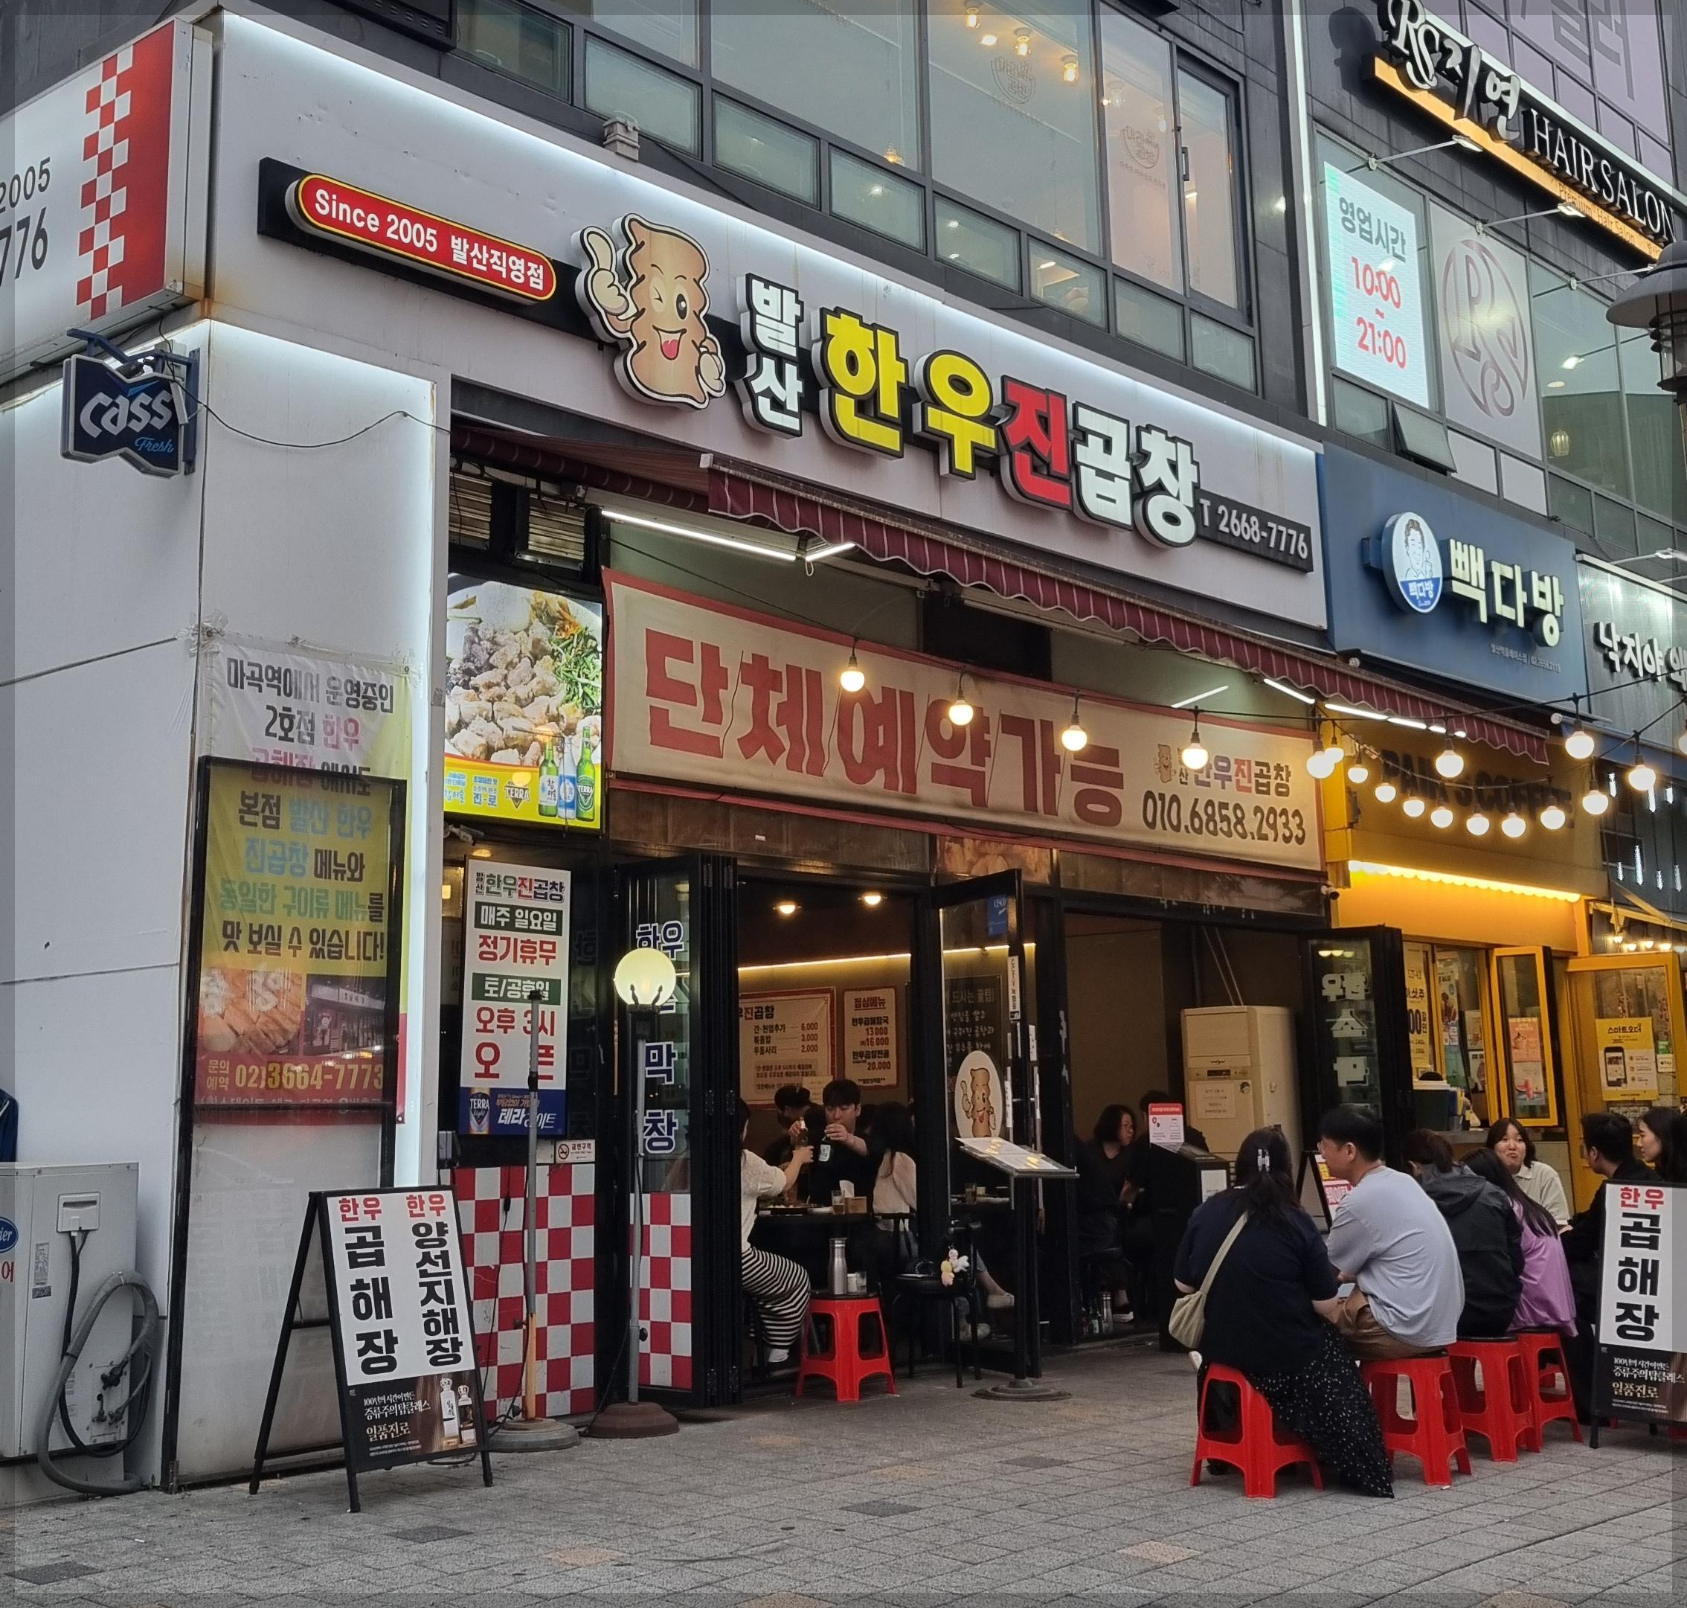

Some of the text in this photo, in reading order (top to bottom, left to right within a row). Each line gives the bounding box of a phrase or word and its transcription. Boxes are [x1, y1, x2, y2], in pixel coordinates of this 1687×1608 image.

[0, 157, 50, 213] 2005
[1530, 108, 1677, 243] HAIR SALON
[314, 189, 438, 254] Since 2005
[1339, 196, 1407, 263] 영업시간
[450, 236, 545, 291] 발산직영점
[1351, 256, 1402, 309] 10:00
[750, 278, 803, 431] 발산
[1356, 316, 1407, 370] 21:00
[134, 436, 175, 454] Fresh
[824, 311, 1200, 546] 한우진곱창
[1201, 501, 1310, 560] T 2668-7776
[1449, 538, 1565, 648] 빽다방
[1599, 621, 1665, 682] 낙지야
[226, 657, 394, 713] 마곡역에서 운영중인
[264, 704, 360, 752] 2호점 한우
[645, 627, 1124, 828] 단체예약가능
[505, 786, 530, 801] TERRA
[577, 784, 594, 793] TERRA
[239, 790, 373, 840] 본점 발산 한우
[1142, 789, 1306, 846] 010.6858.2933
[245, 837, 365, 883] 진곱창 메뉴와
[220, 878, 385, 923] 동일한 구이류 메뉴를
[485, 872, 565, 903] 한우진곱창
[221, 920, 385, 961] 맛 보실 수 있습니다!
[480, 905, 557, 932] 매주 일요일
[478, 934, 557, 966] 정기휴무
[484, 977, 550, 1000] 토/공휴일
[475, 1006, 515, 1034] 오후
[1607, 1024, 1643, 1035] 스마트오더
[206, 1076, 229, 1091] 예약
[208, 1059, 230, 1075] 문의
[235, 1062, 384, 1090] 02)3664-7773
[470, 1098, 490, 1109] TERRA
[339, 1193, 446, 1222] 한우 한우
[1619, 1186, 1664, 1210] 한우
[411, 1220, 464, 1368] 양선지해장
[1614, 1211, 1662, 1343] 곱해장
[344, 1224, 399, 1376] 곱해장
[1612, 1365, 1648, 1381] 증류주의
[1612, 1381, 1659, 1399] 일품진로
[364, 1403, 398, 1421] 증류주의
[366, 1421, 411, 1442] 일품진로
